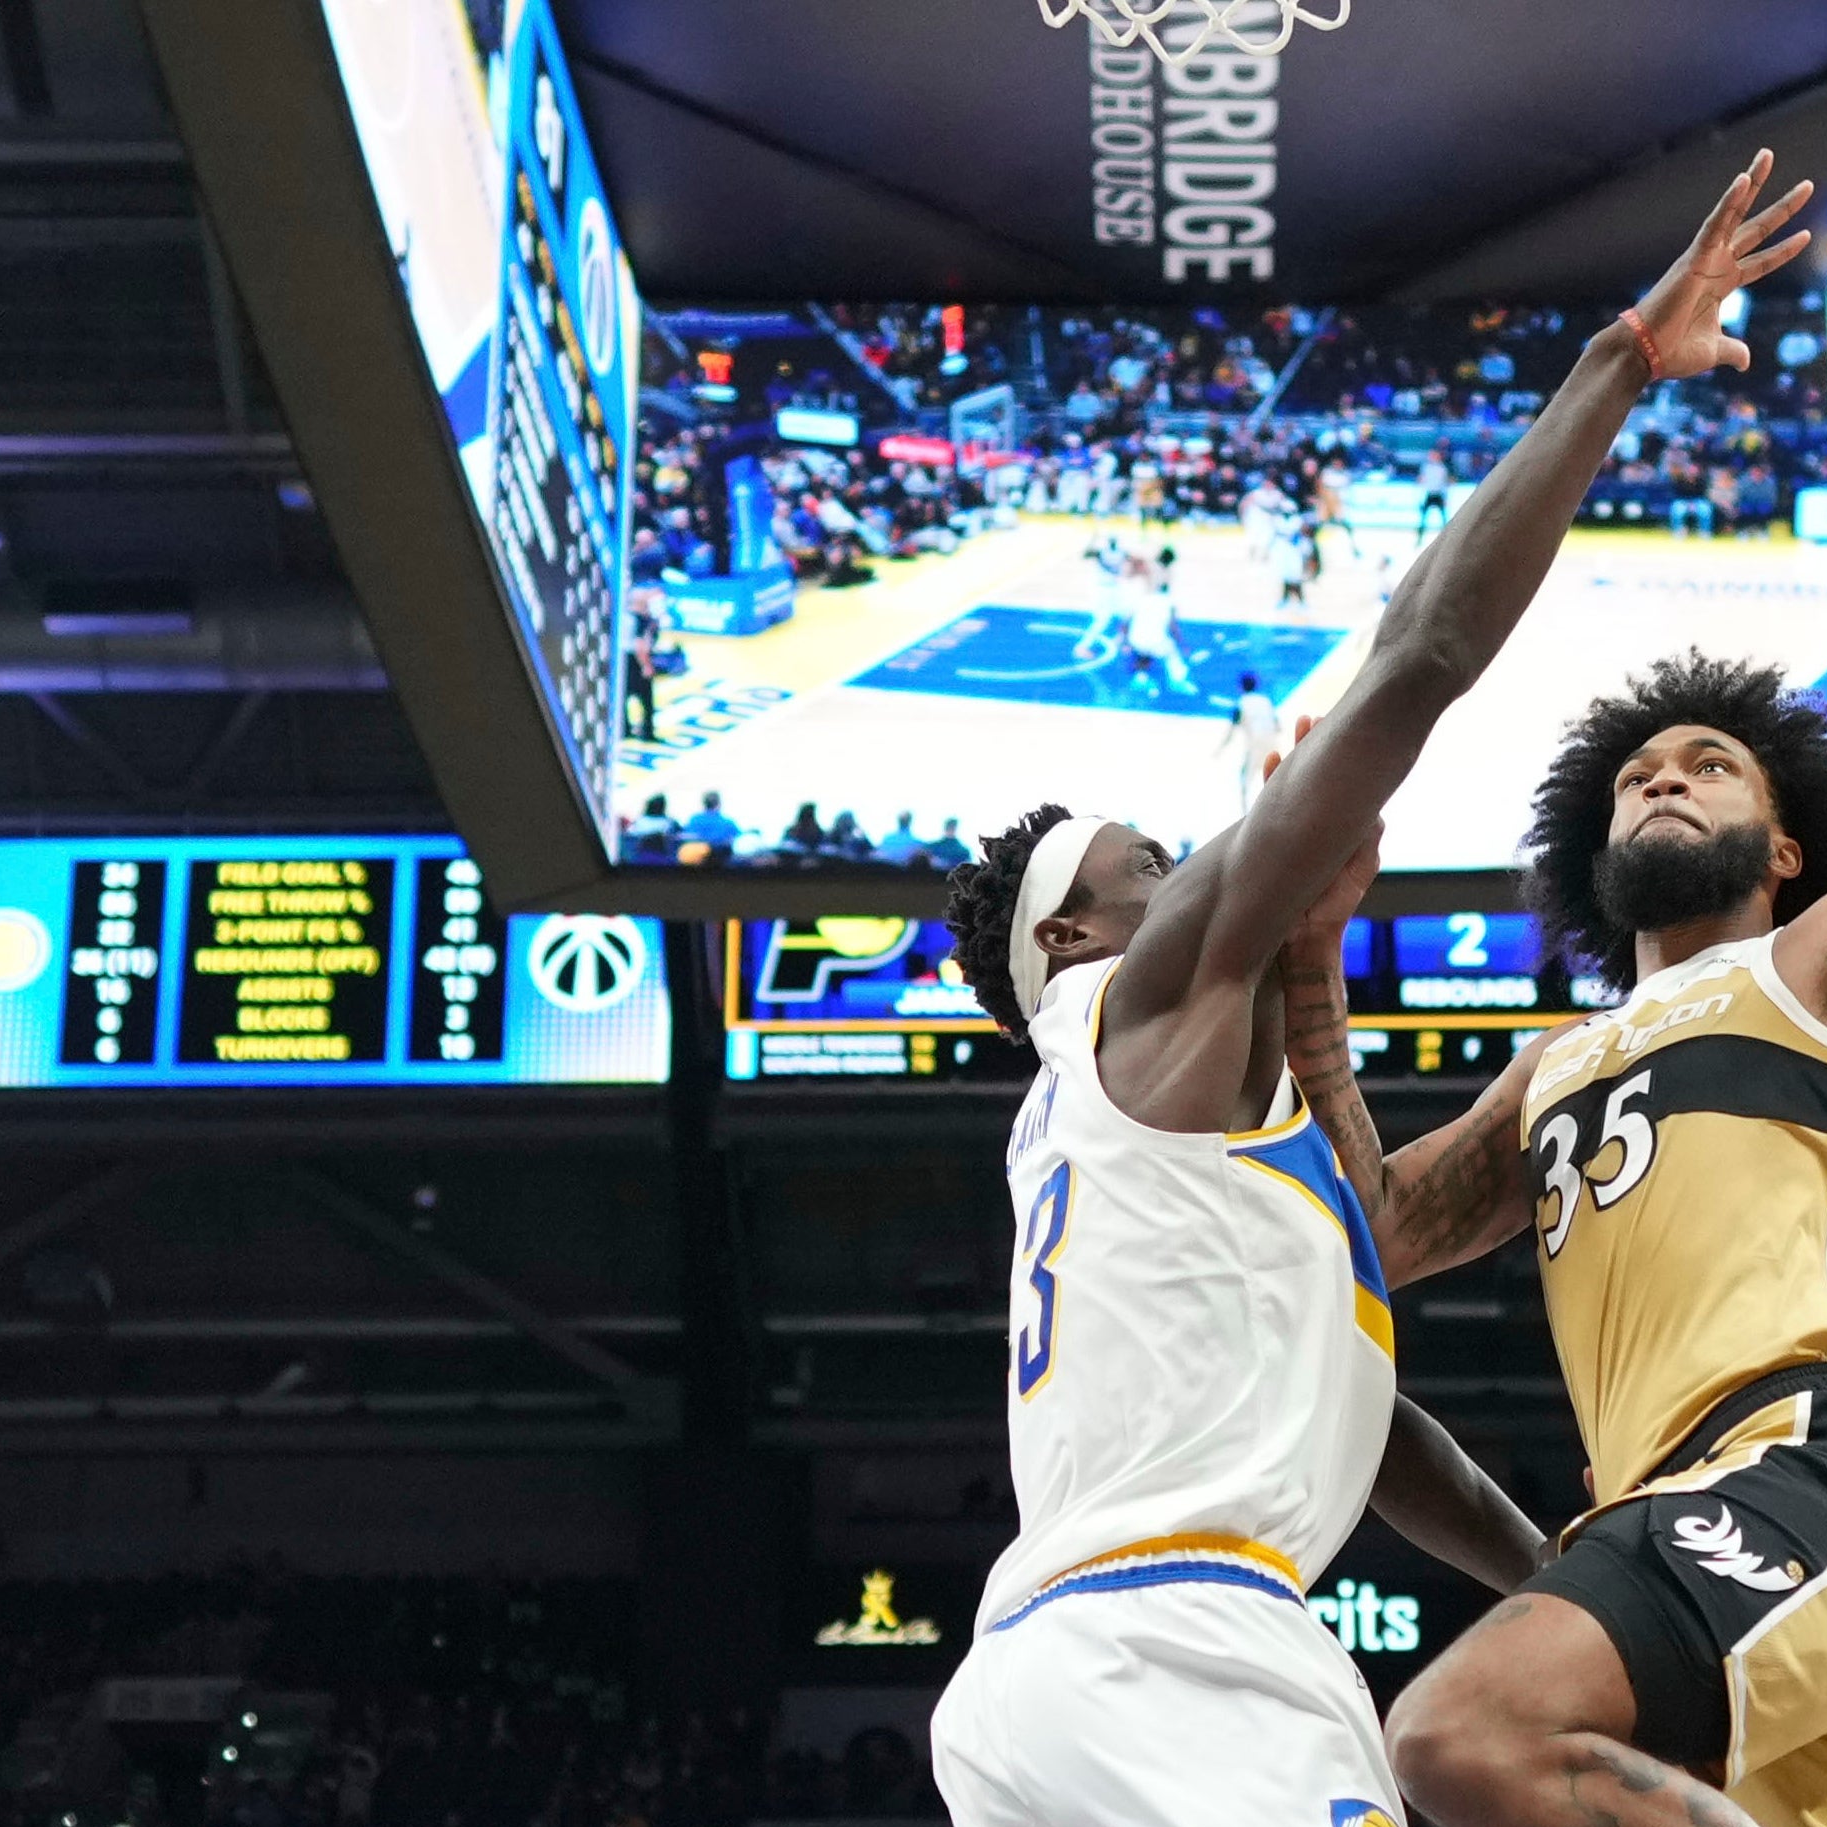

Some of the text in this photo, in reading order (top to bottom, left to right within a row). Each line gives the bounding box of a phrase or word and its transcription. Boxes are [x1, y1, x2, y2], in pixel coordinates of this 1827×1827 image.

[267, 890, 347, 913] THROW
[1450, 914, 1486, 964] 2
[196, 949, 315, 972] REBOUNDS
[238, 978, 332, 1001] ASSISTS
[1402, 979, 1537, 1006] REBOUNDS
[238, 1007, 328, 1031] BLOCKS
[216, 1036, 349, 1060] TURNOVERS
[1527, 992, 1734, 1104] washngton
[1537, 1068, 1658, 1262] 35
[1301, 1575, 1418, 1655] rits
